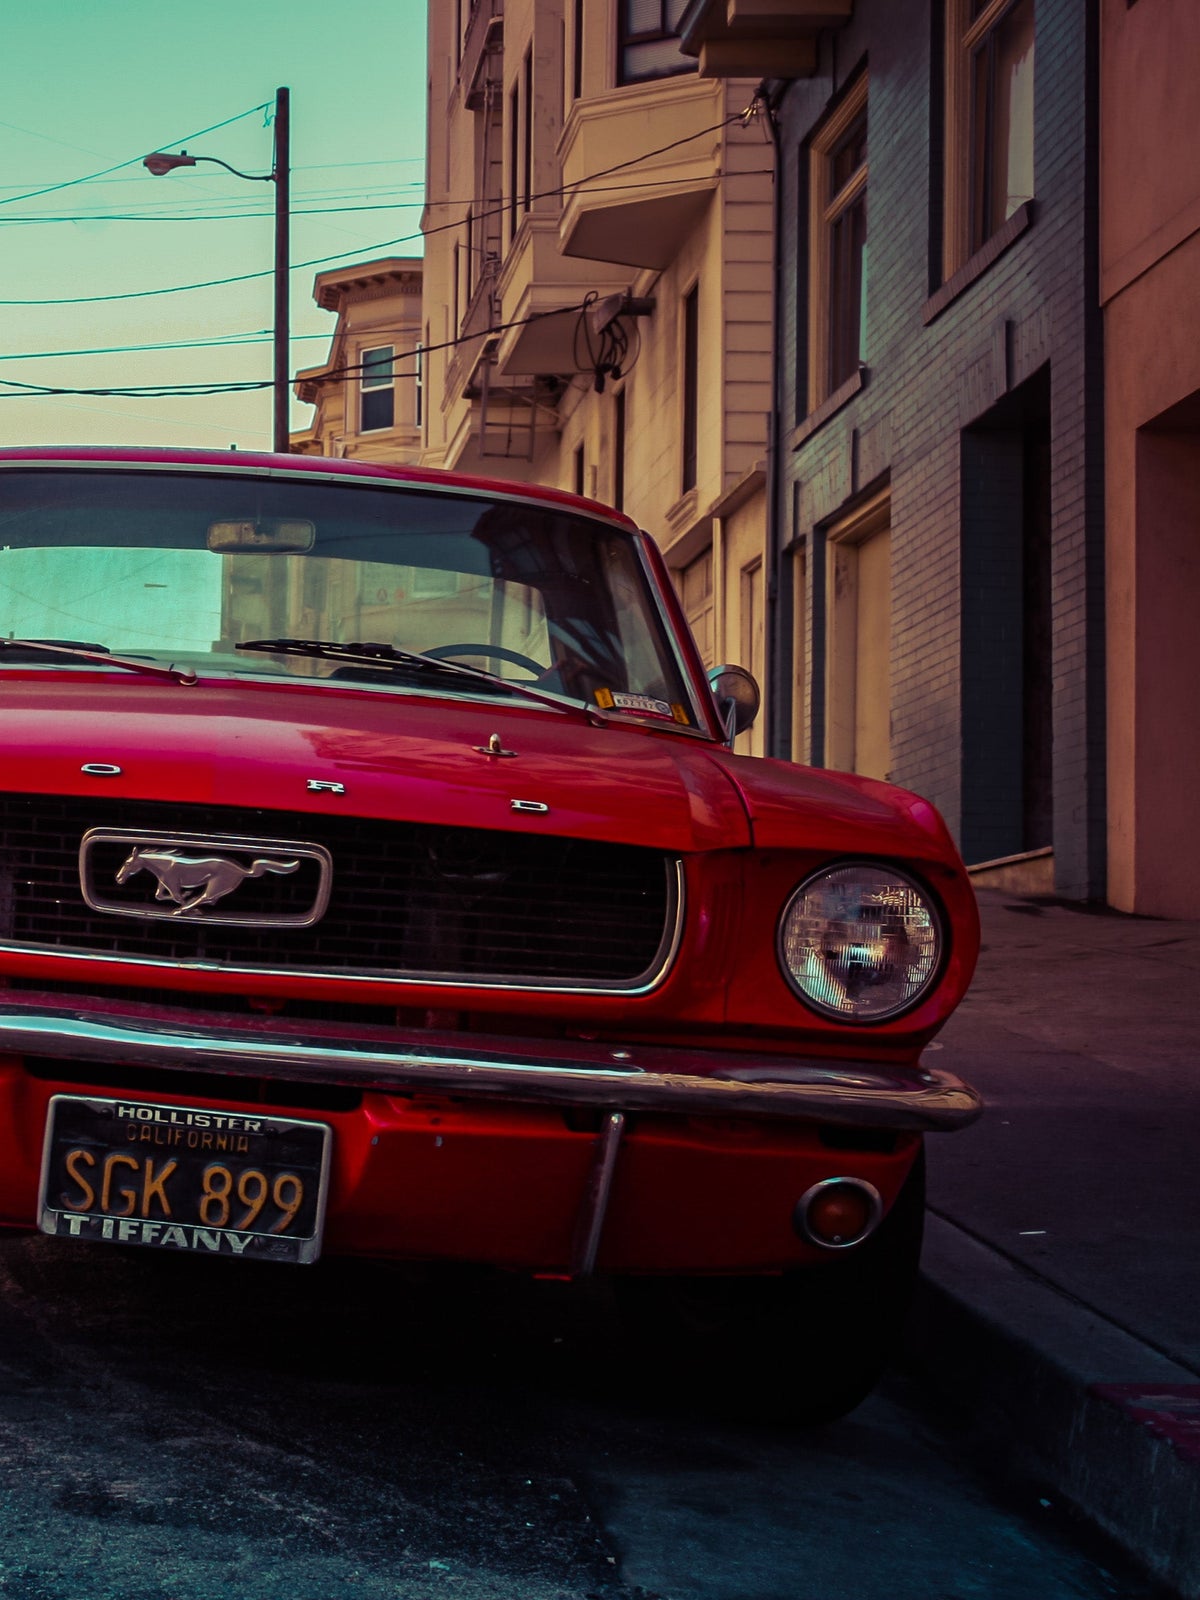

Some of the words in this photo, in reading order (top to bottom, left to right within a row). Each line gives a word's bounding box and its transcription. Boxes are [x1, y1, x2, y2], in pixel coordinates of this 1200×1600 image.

[118, 1105, 262, 1132] HOLLISTER
[126, 1123, 250, 1153] CALIFORNIA
[60, 1149, 178, 1218] SGK
[197, 1165, 304, 1234] 899
[62, 1214, 255, 1254] TIFFANY
